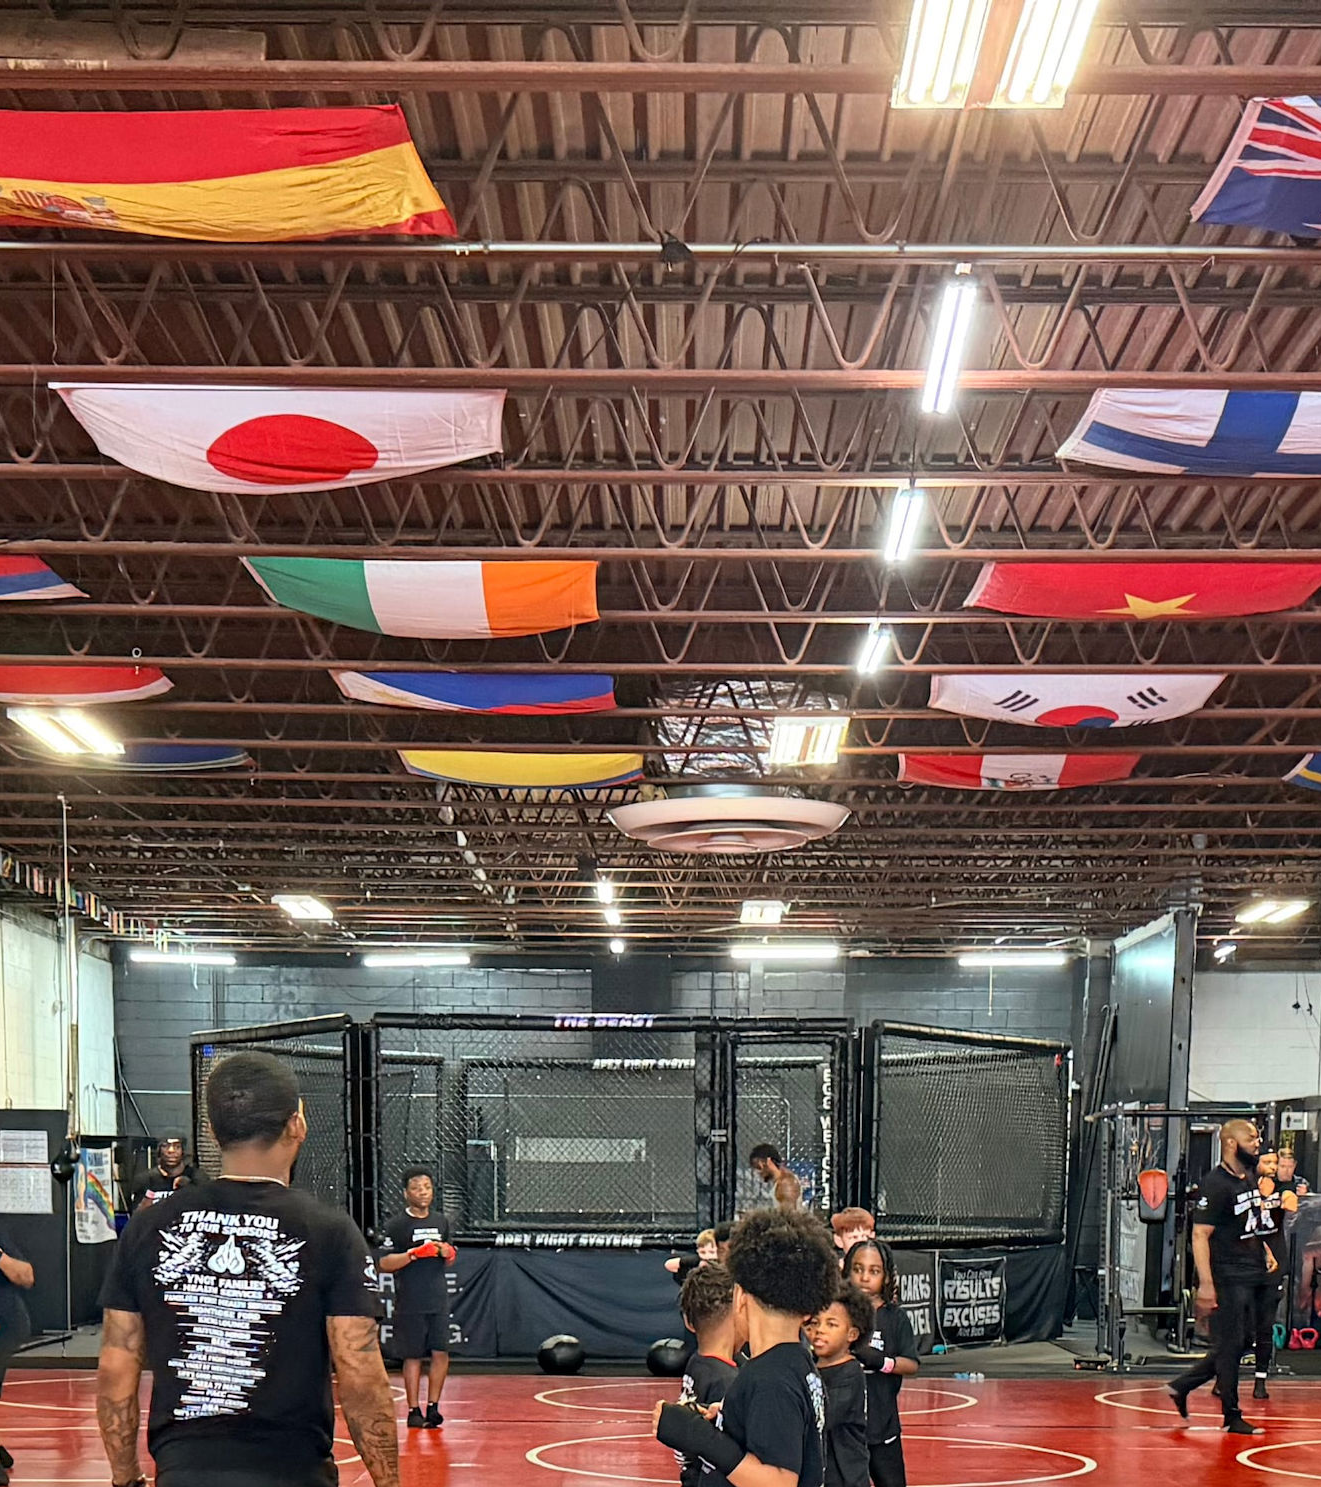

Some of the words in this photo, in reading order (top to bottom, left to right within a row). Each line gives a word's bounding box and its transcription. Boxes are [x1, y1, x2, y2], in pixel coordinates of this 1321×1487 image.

[179, 1222, 194, 1233] TO
[196, 1222, 220, 1234] OUR
[181, 1210, 241, 1227] THANK
[243, 1214, 279, 1230] YOU
[943, 1304, 1001, 1328] EXCUSES
